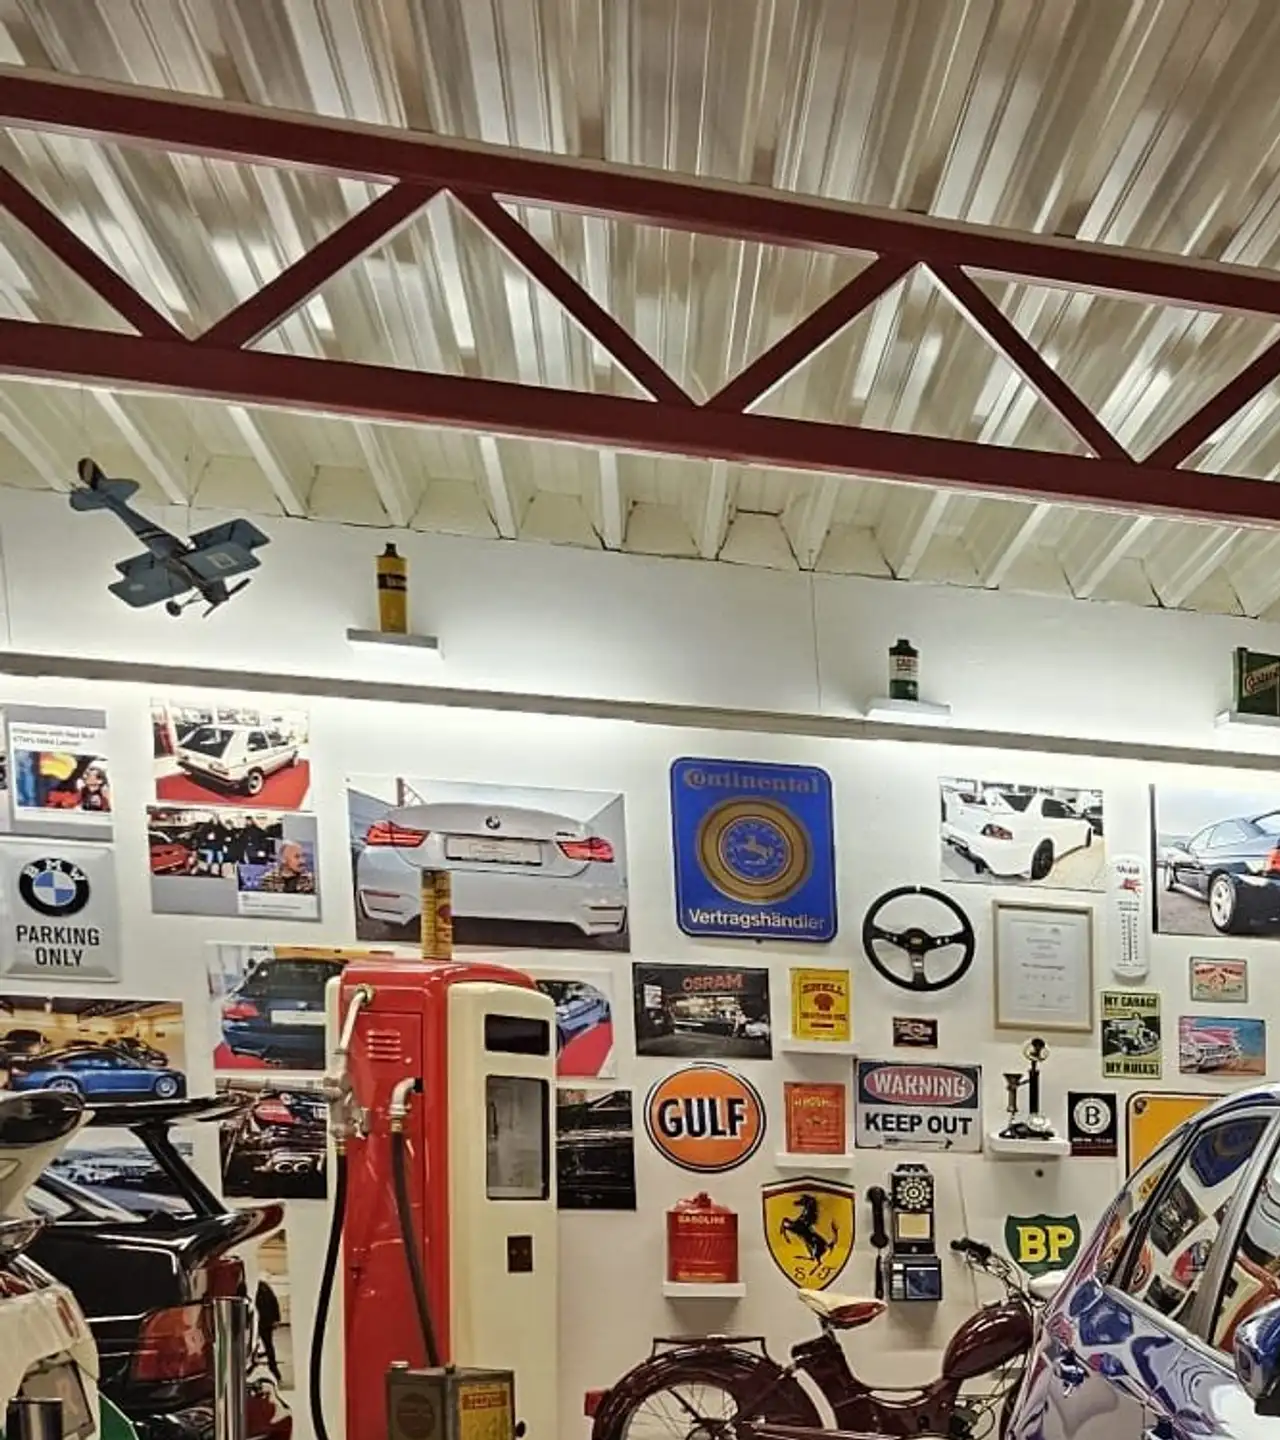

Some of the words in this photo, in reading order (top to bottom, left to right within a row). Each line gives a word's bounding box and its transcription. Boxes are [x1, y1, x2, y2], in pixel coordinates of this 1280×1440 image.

[684, 768, 818, 794] Continental
[24, 857, 87, 883] BMW
[689, 907, 825, 931] Vertragshändler
[16, 924, 100, 947] PARKING
[35, 948, 83, 968] ONLY
[682, 974, 743, 992] OSRAM
[1104, 994, 1119, 1006] MY
[1121, 996, 1157, 1008] GARAGE
[1106, 1062, 1121, 1074] MY
[1124, 1063, 1159, 1076] RULES!
[874, 1071, 968, 1098] WARNING
[658, 1098, 745, 1139] GULF
[866, 1111, 921, 1133] KEEP
[927, 1116, 972, 1135] OUT
[1085, 1106, 1101, 1126] B
[1016, 1224, 1075, 1263] BP
